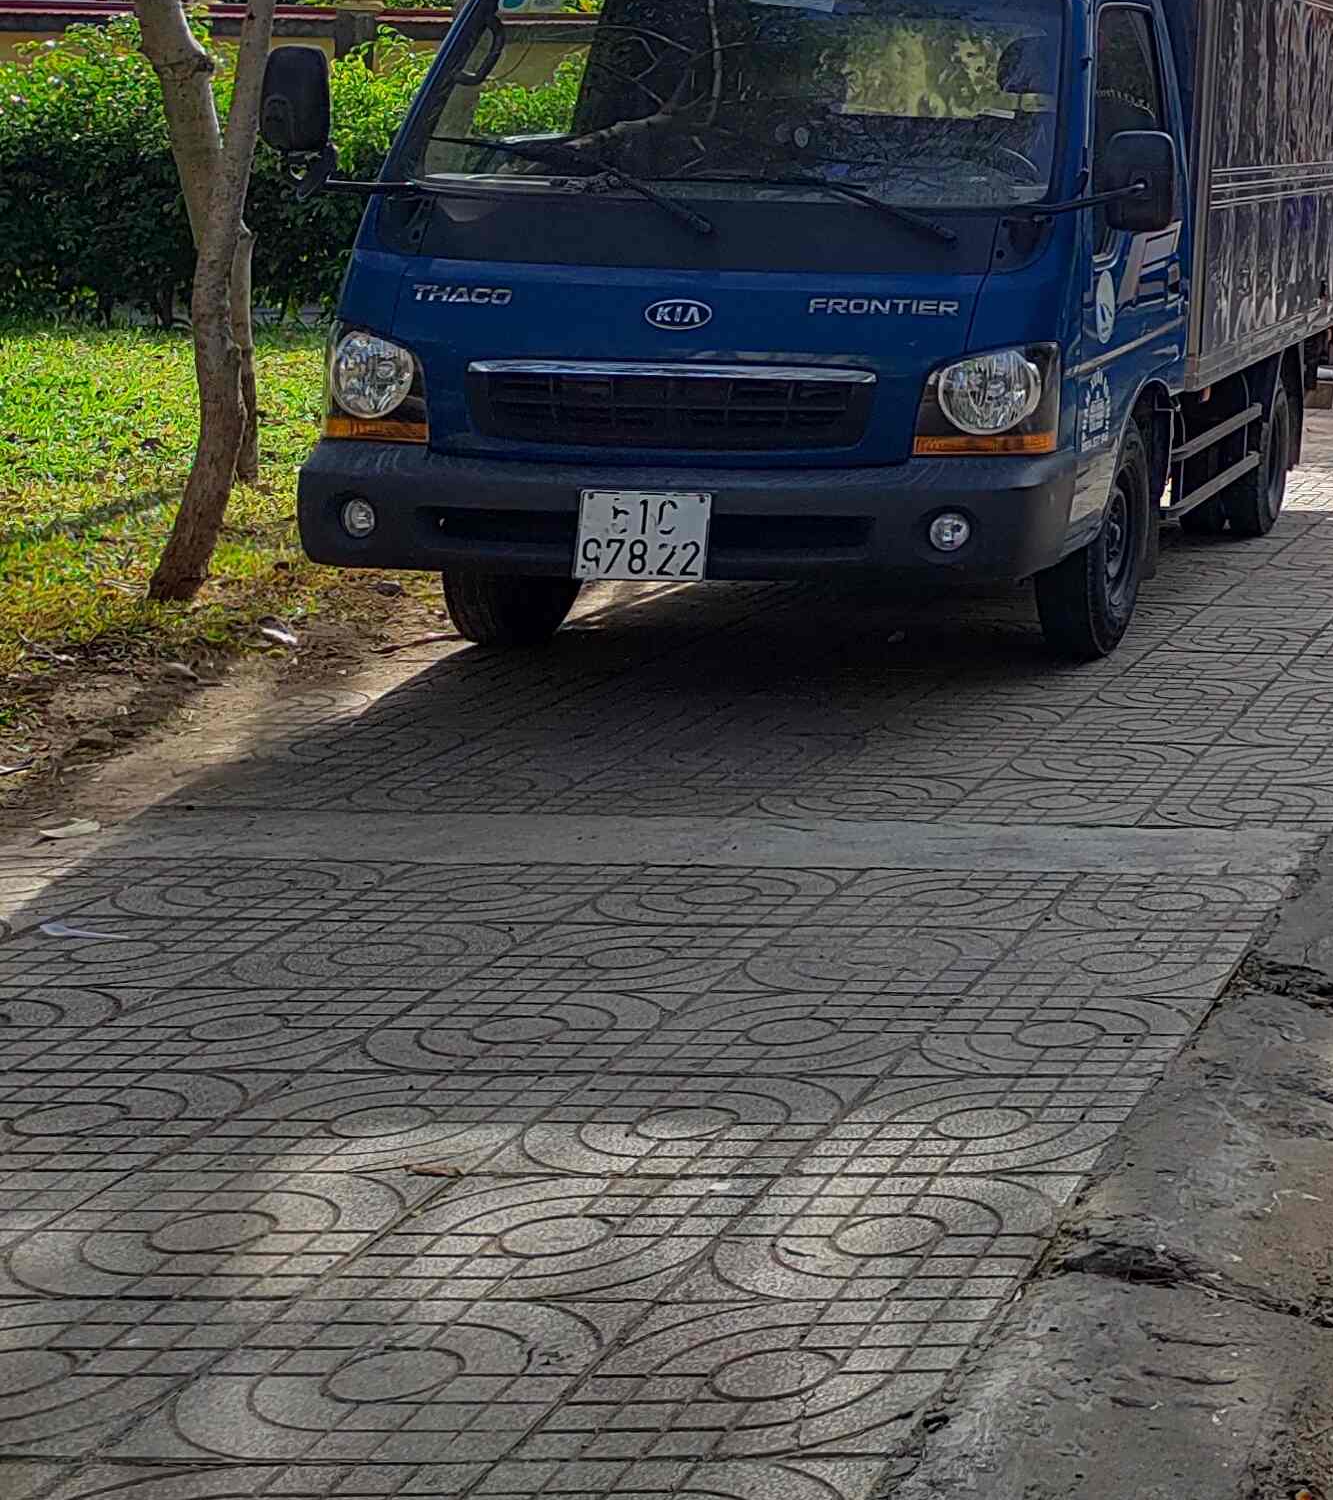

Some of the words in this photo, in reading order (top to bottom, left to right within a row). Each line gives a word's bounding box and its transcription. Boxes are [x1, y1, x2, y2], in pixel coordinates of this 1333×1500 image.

[412, 283, 513, 306] THACO
[655, 305, 701, 323] KIA
[808, 298, 960, 317] FRONTIER
